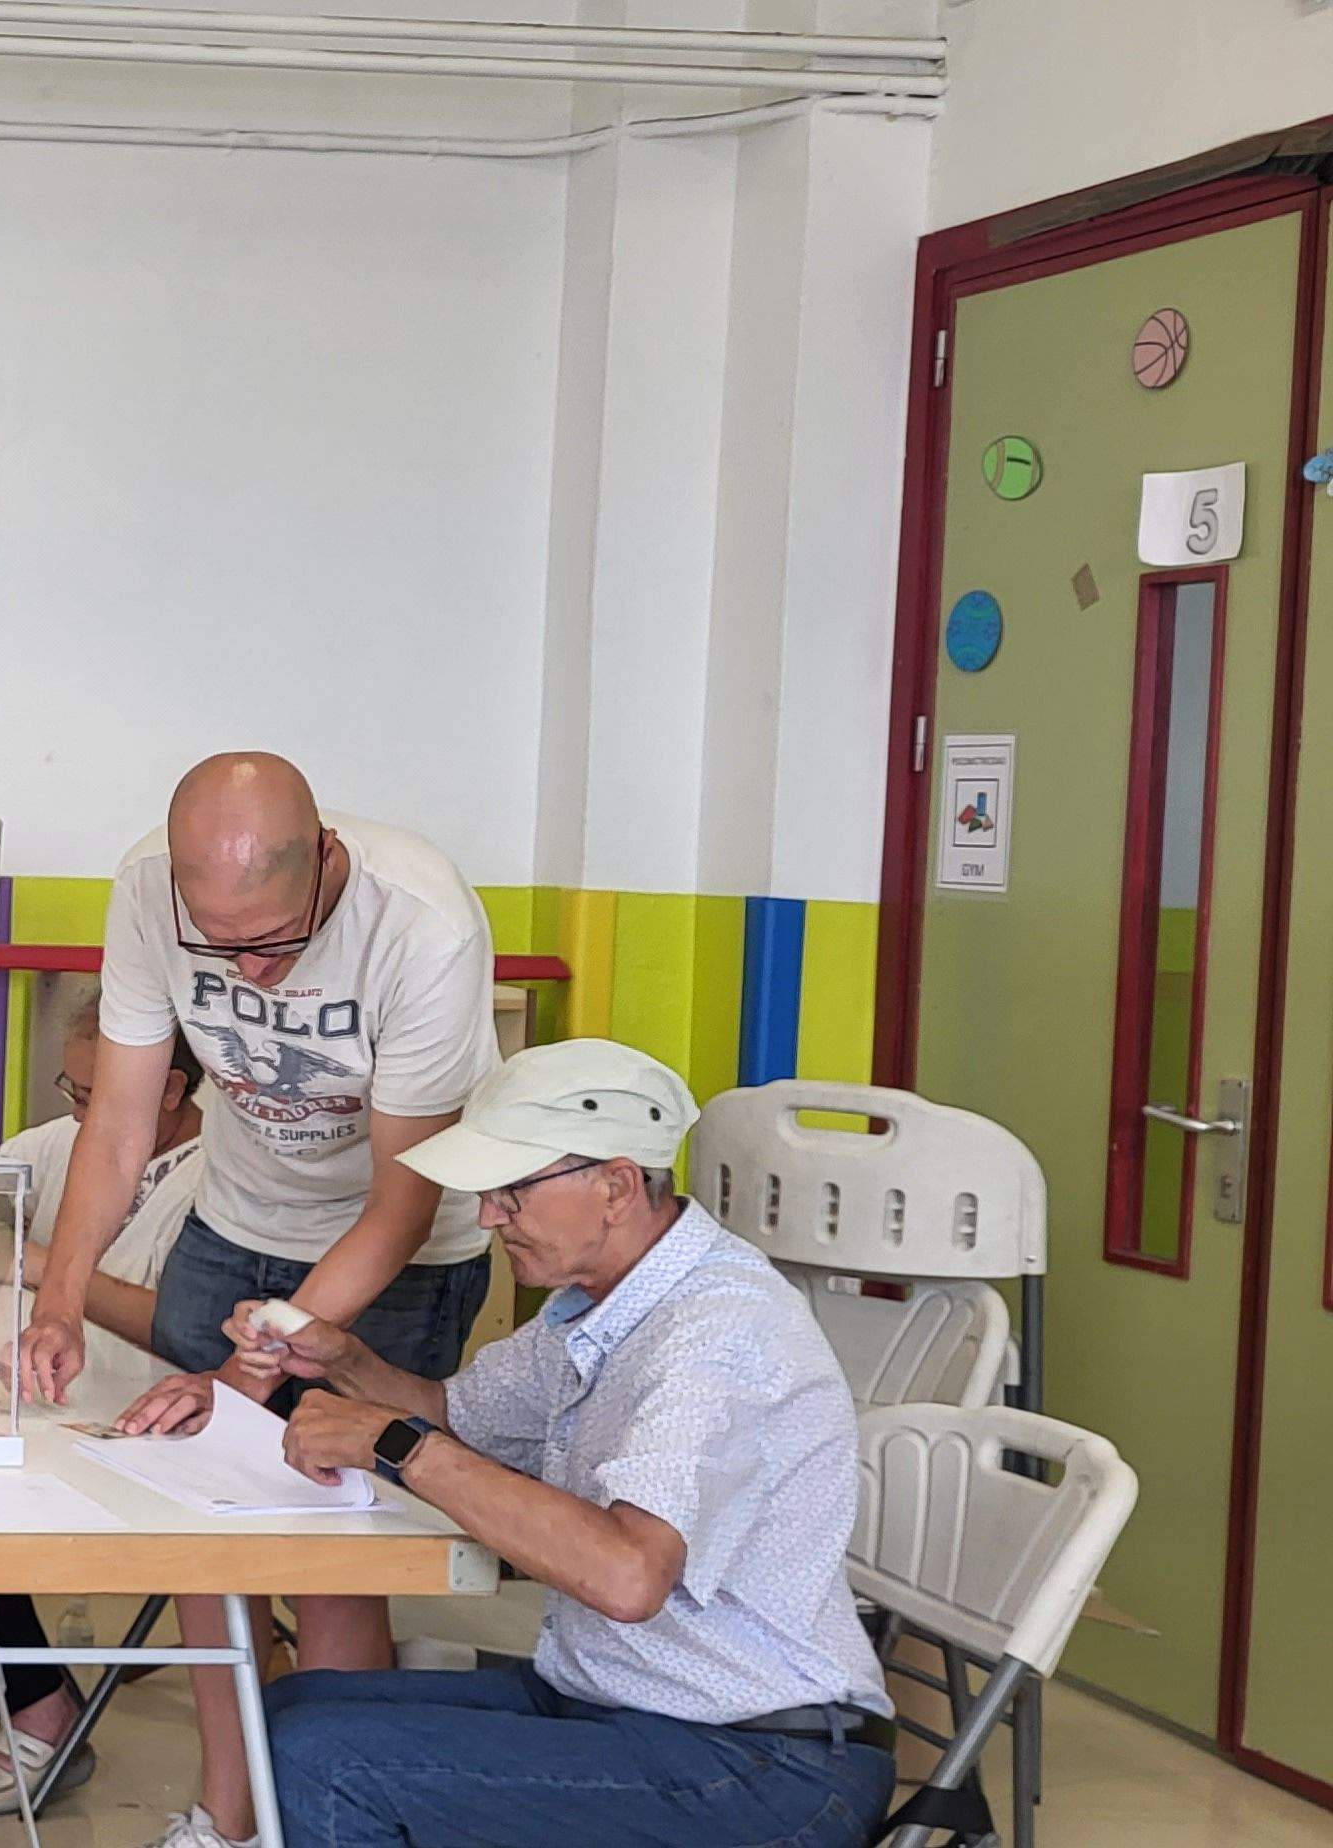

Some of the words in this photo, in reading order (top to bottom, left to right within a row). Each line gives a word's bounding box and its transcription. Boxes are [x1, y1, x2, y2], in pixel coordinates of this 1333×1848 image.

[1186, 488, 1218, 555] 5
[961, 863, 985, 877] GYM
[192, 971, 359, 1037] POLO
[278, 1123, 357, 1141] SUPPLIES
